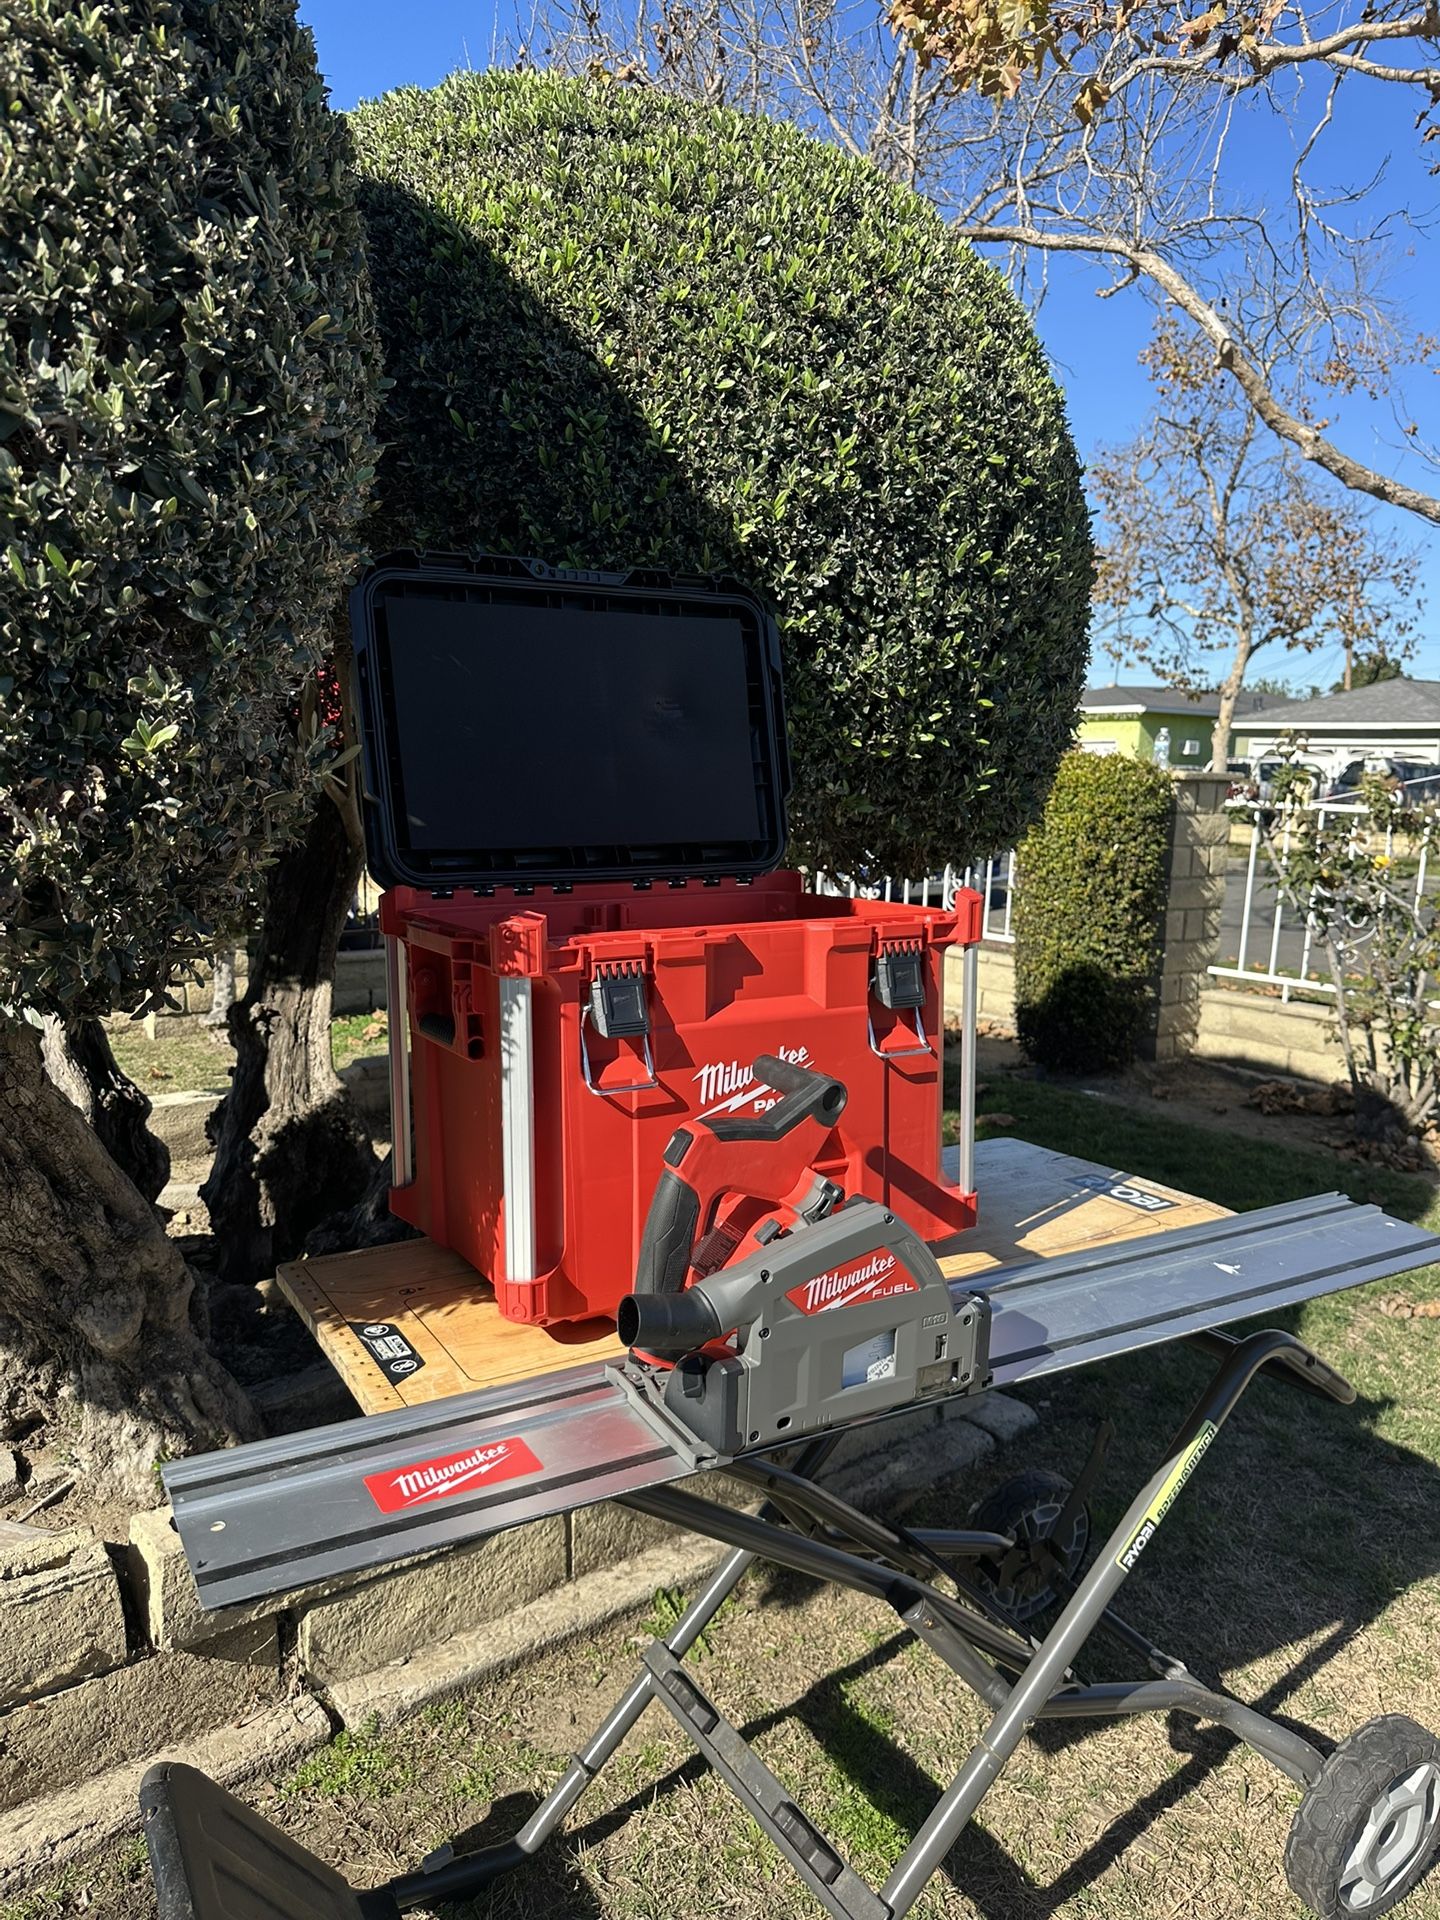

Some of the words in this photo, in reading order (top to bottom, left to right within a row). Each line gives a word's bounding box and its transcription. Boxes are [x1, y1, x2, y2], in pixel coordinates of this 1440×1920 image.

[693, 1045, 810, 1105] Milwkee
[802, 1256, 896, 1310] Milwaukee
[872, 1283, 914, 1299] FUEL
[389, 1444, 510, 1497] Milwaukee
[1122, 1521, 1156, 1567] RYOBI
